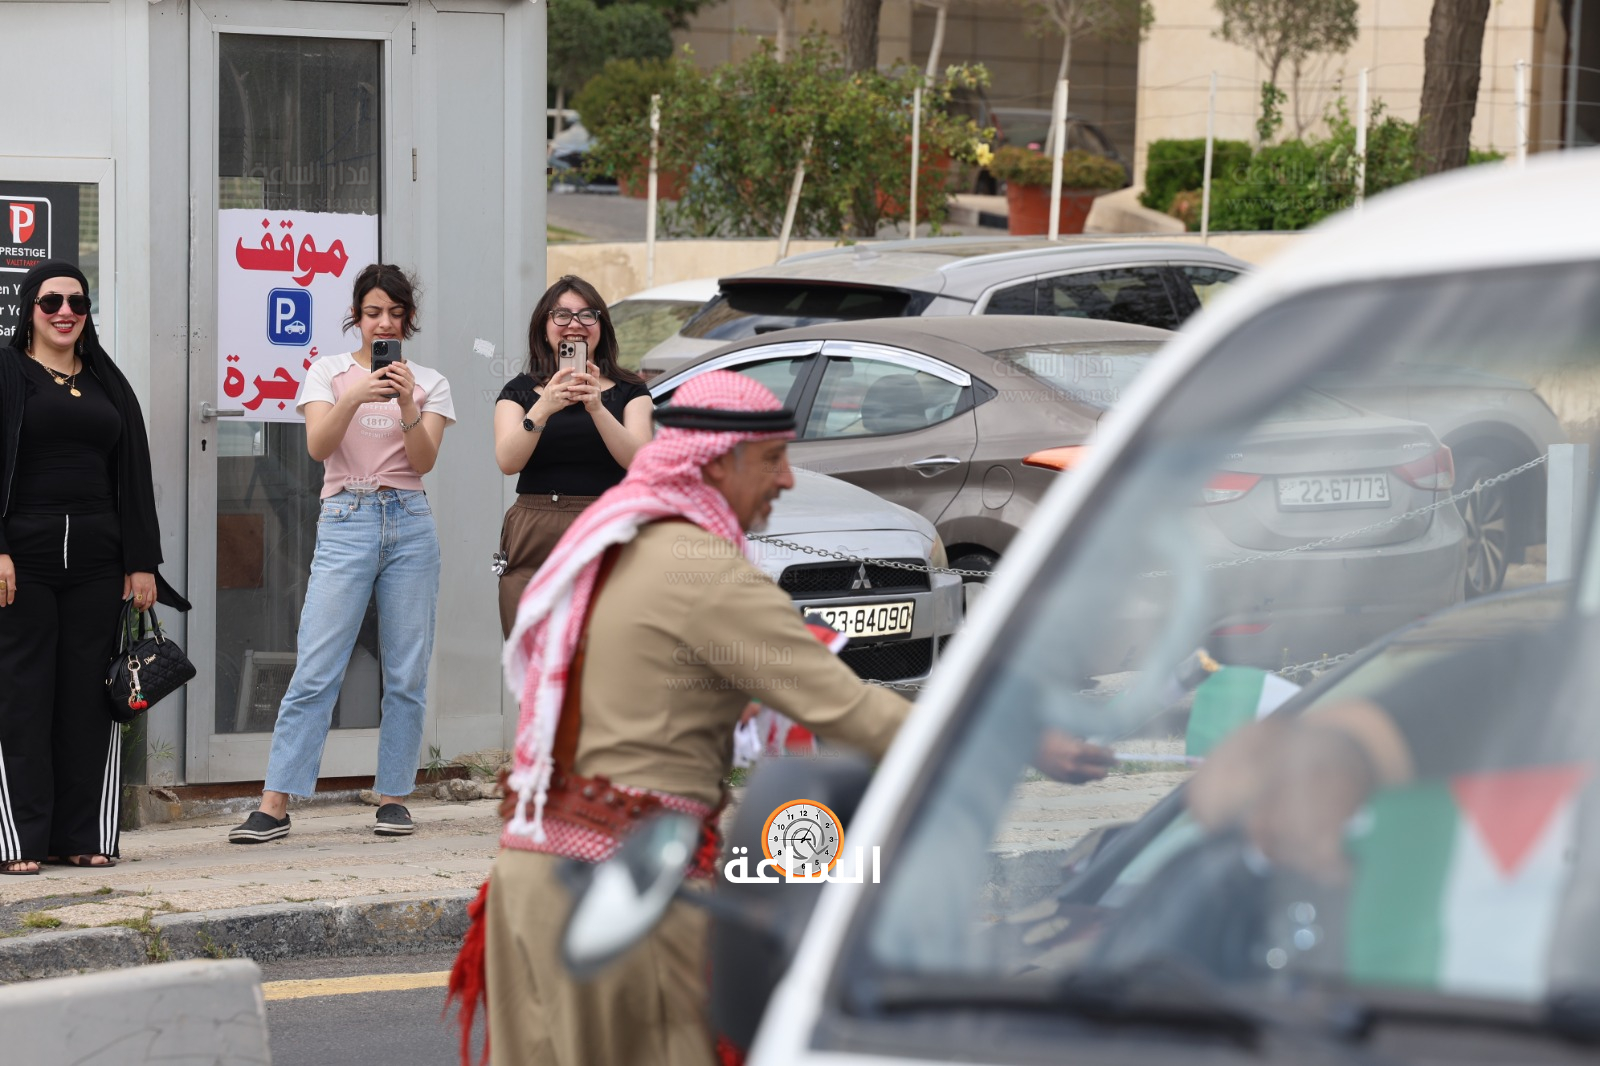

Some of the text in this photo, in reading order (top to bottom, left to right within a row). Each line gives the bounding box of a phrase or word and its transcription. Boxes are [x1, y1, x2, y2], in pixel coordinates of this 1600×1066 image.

[10, 205, 33, 243] P
[0, 247, 46, 258] PRESTIGE
[236, 218, 349, 287] موقف
[275, 297, 296, 334] P
[366, 418, 388, 426] 1817
